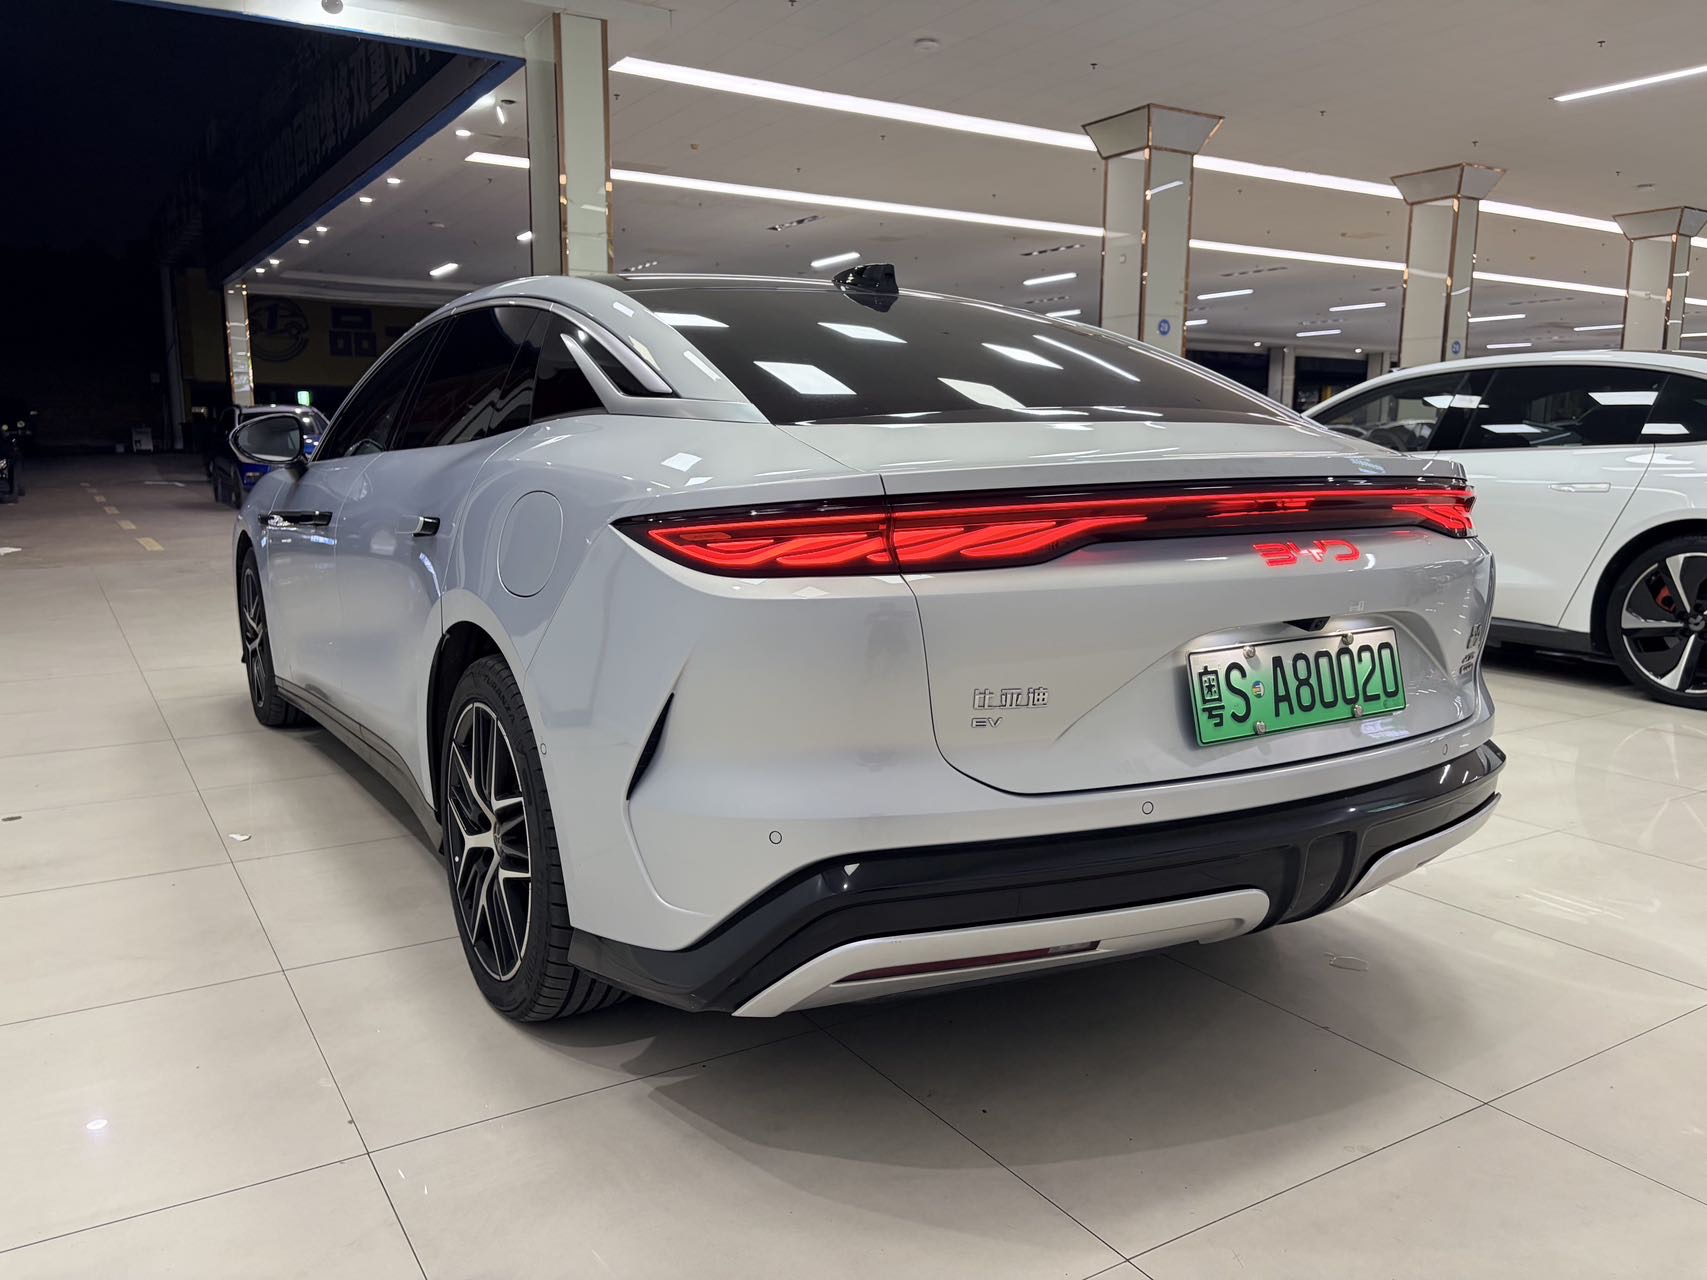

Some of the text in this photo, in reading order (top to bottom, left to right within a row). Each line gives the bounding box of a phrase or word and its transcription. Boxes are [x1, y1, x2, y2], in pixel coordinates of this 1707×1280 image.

[1252, 539, 1361, 568] BYD
[973, 686, 1048, 710] 比亚迪
[971, 717, 1003, 728] EV
